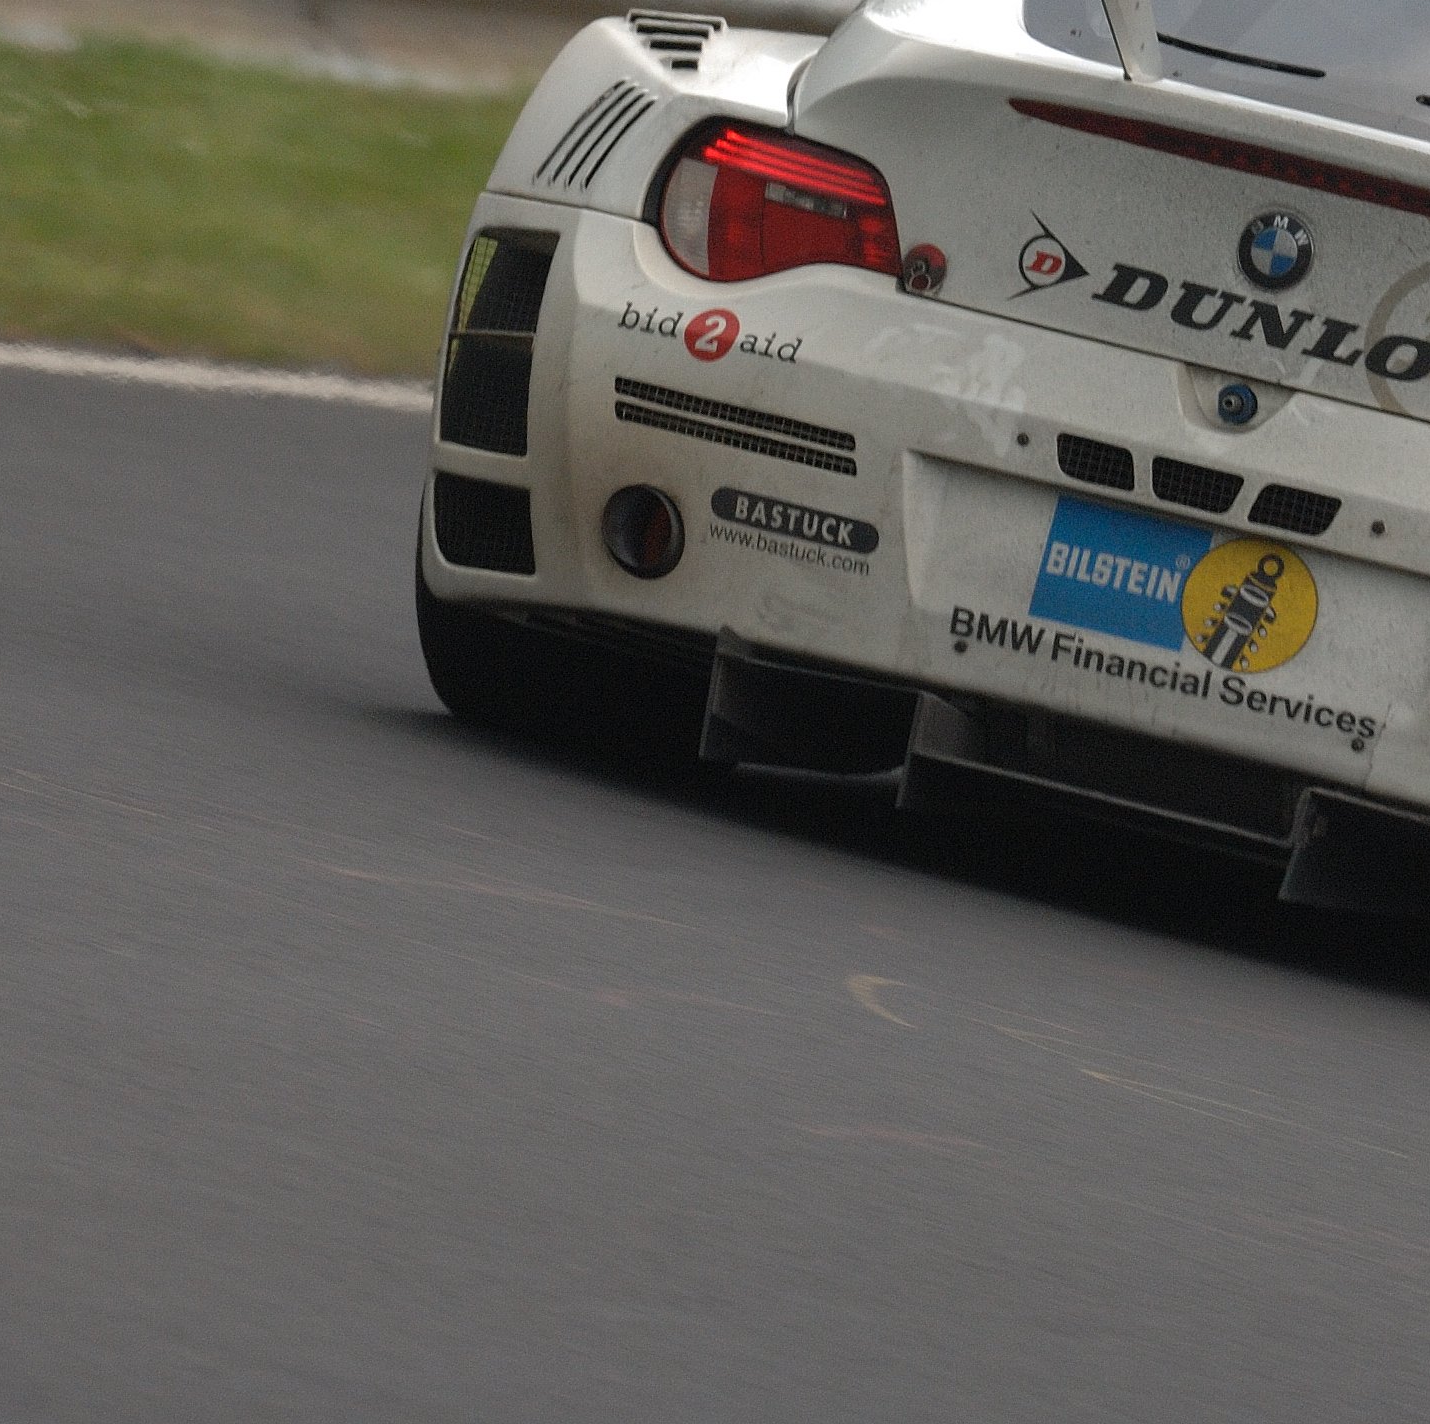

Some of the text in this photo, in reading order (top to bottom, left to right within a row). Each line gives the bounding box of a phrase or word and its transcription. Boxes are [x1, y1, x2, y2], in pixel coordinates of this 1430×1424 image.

[617, 303, 682, 340] bid
[739, 331, 803, 364] aid
[709, 522, 871, 576] www.bastuck.com
[734, 495, 854, 546] BASTUCK
[1046, 541, 1183, 603] BILSTEIN
[949, 605, 1377, 740] BMW Financial Services
